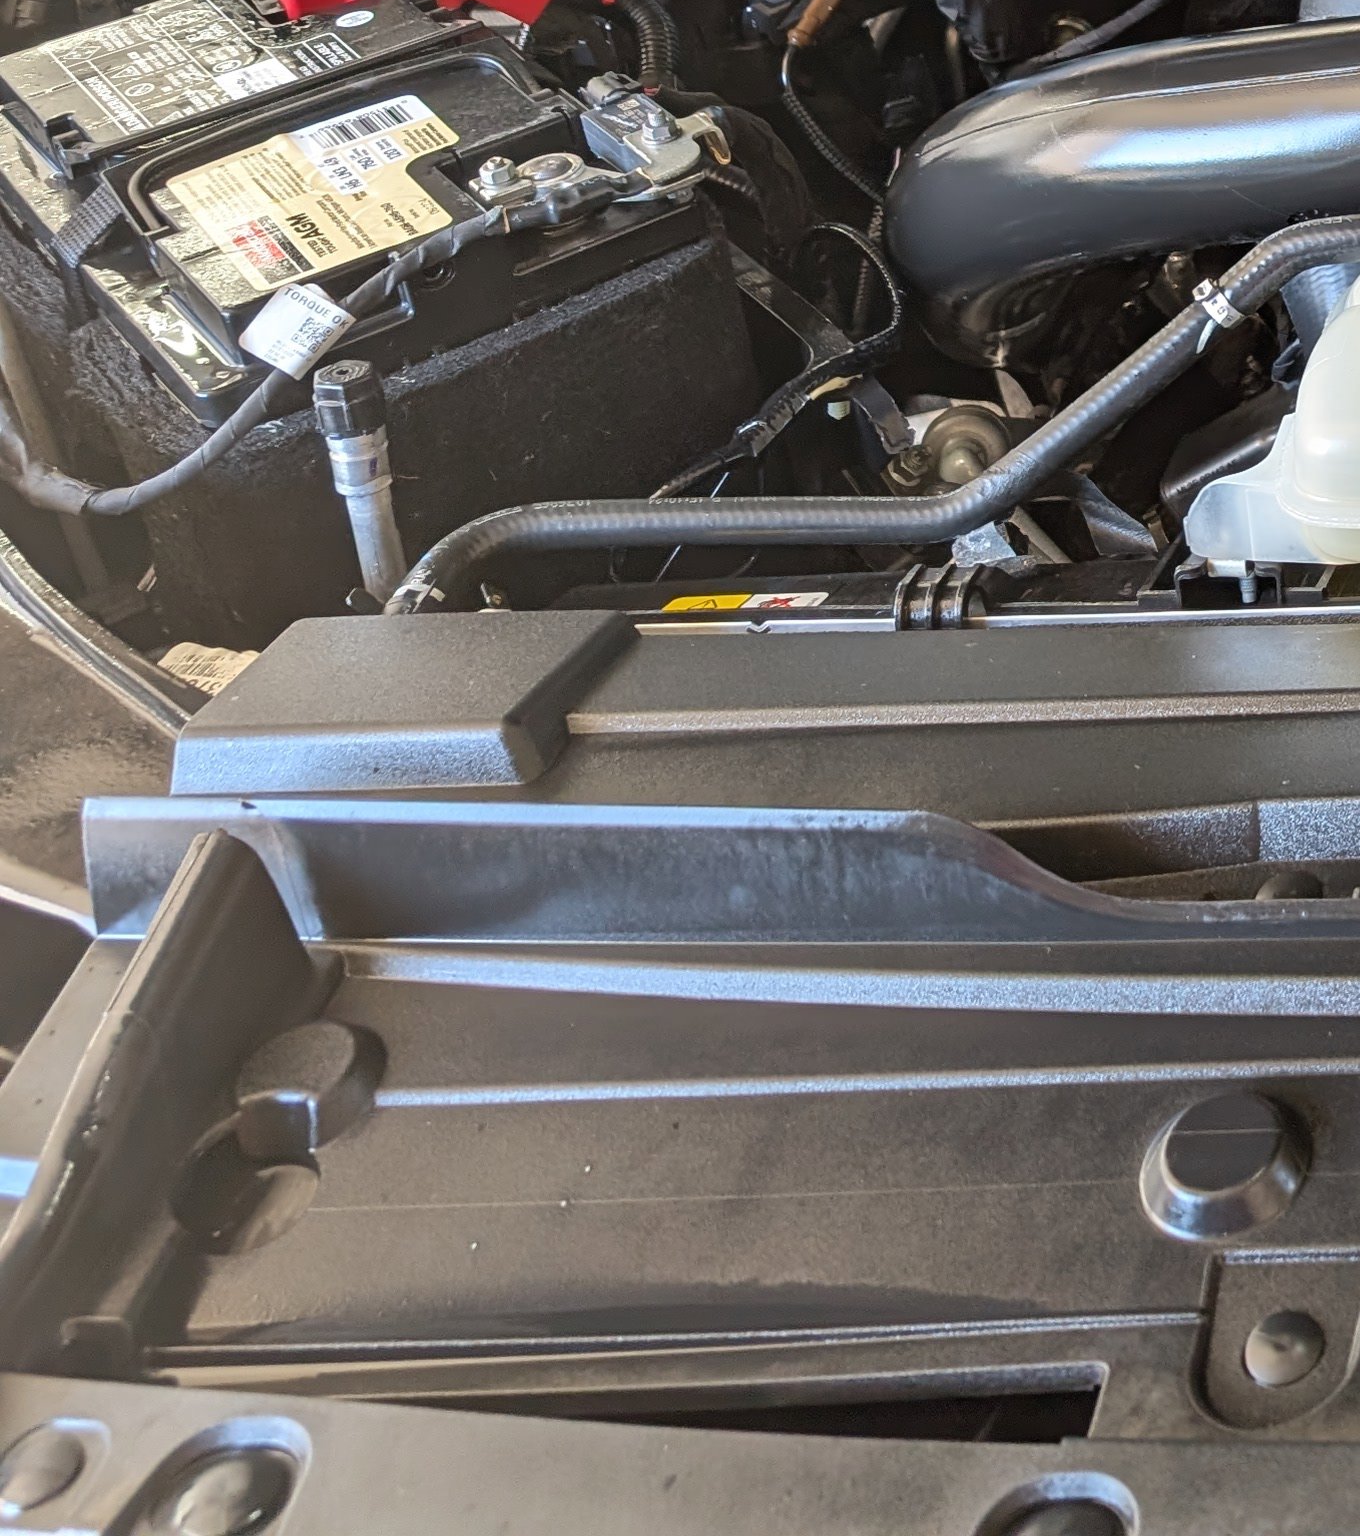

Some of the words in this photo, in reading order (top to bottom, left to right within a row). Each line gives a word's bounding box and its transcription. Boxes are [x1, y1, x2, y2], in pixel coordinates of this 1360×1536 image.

[284, 211, 324, 241] AGM
[283, 288, 334, 320] TORQUE
[331, 313, 350, 331] OK
